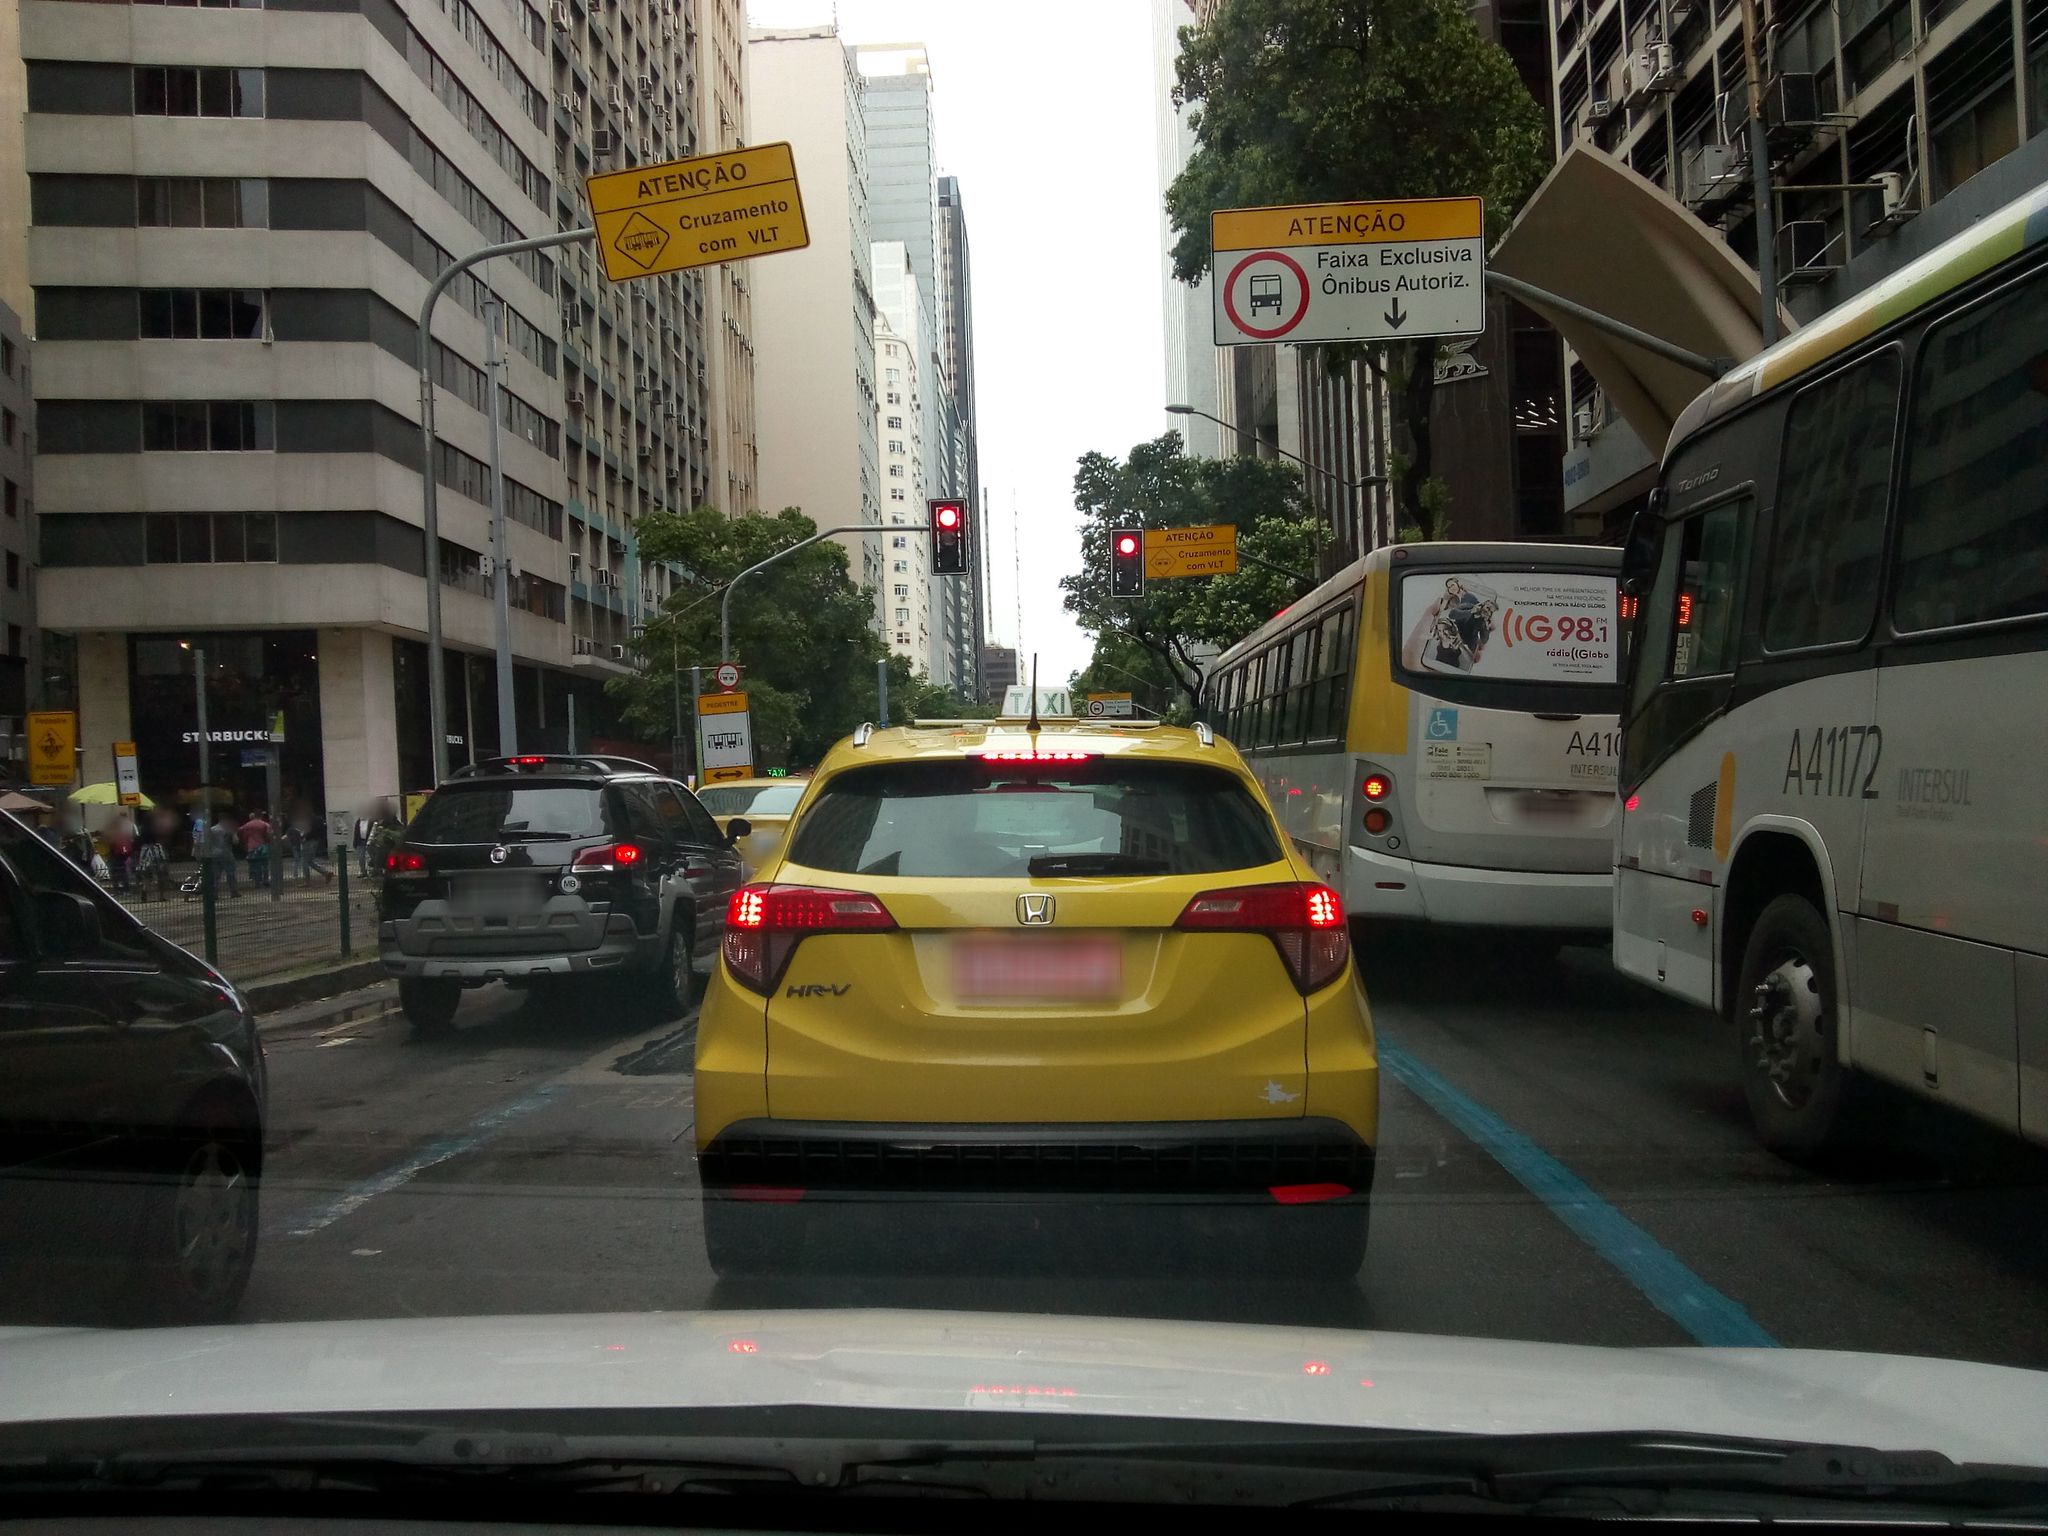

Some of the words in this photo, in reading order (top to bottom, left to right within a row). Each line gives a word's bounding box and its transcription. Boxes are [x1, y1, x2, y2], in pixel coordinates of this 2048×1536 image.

[638, 162, 747, 199] ATENÇÃO
[679, 199, 789, 230] Cruzamento
[1288, 209, 1405, 238] ATENÇÃO
[699, 236, 736, 254] com
[748, 226, 778, 245] VLT
[1317, 251, 1369, 269] Faixa
[1380, 246, 1472, 266] Exclusiva
[1322, 272, 1390, 295] Ônibus
[1395, 273, 1469, 292] Autoriz.
[1678, 468, 1720, 493] Torino
[1165, 531, 1214, 542] ATENÇÃO
[1178, 549, 1231, 559] Cruzamento
[1207, 560, 1224, 569] VLT
[1557, 616, 1607, 643] 98.1
[1546, 648, 1570, 657] rádio
[1009, 692, 1065, 714] TAXI
[767, 768, 786, 777] TAXI
[1782, 725, 1883, 800] A41172
[1899, 768, 1972, 806] INTERSUL
[786, 984, 852, 999] HR-V
